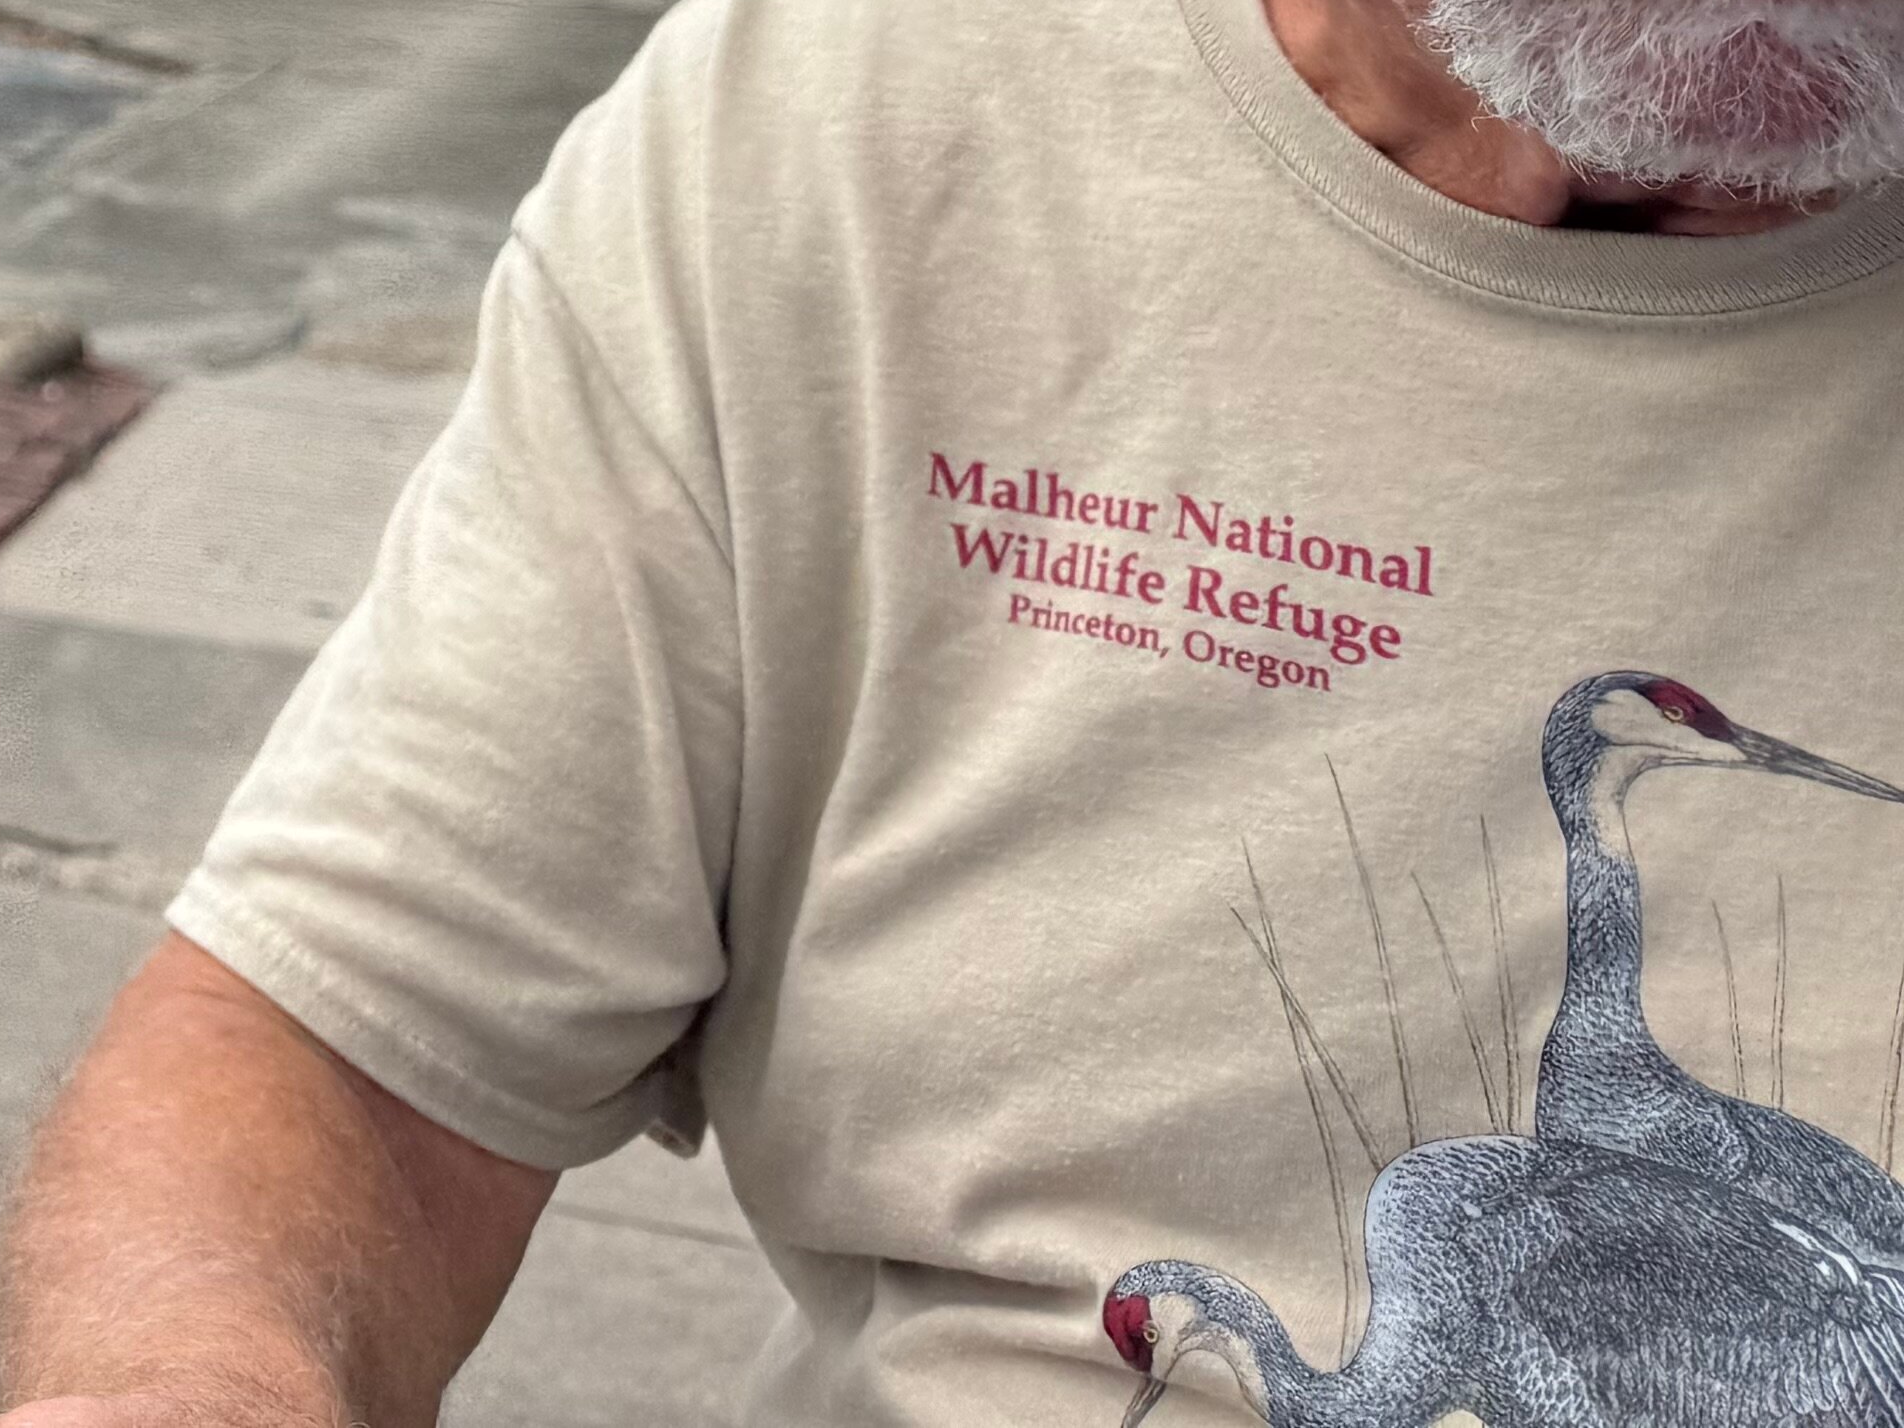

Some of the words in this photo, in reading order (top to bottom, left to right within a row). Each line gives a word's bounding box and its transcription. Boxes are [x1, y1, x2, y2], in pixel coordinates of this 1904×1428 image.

[928, 451, 1159, 533] Malheur
[1173, 494, 1435, 596] National
[950, 522, 1166, 605] Wildlife
[1184, 563, 1403, 666] Refuge
[1008, 594, 1170, 659] Princeton,
[1183, 630, 1332, 692] Oregon
